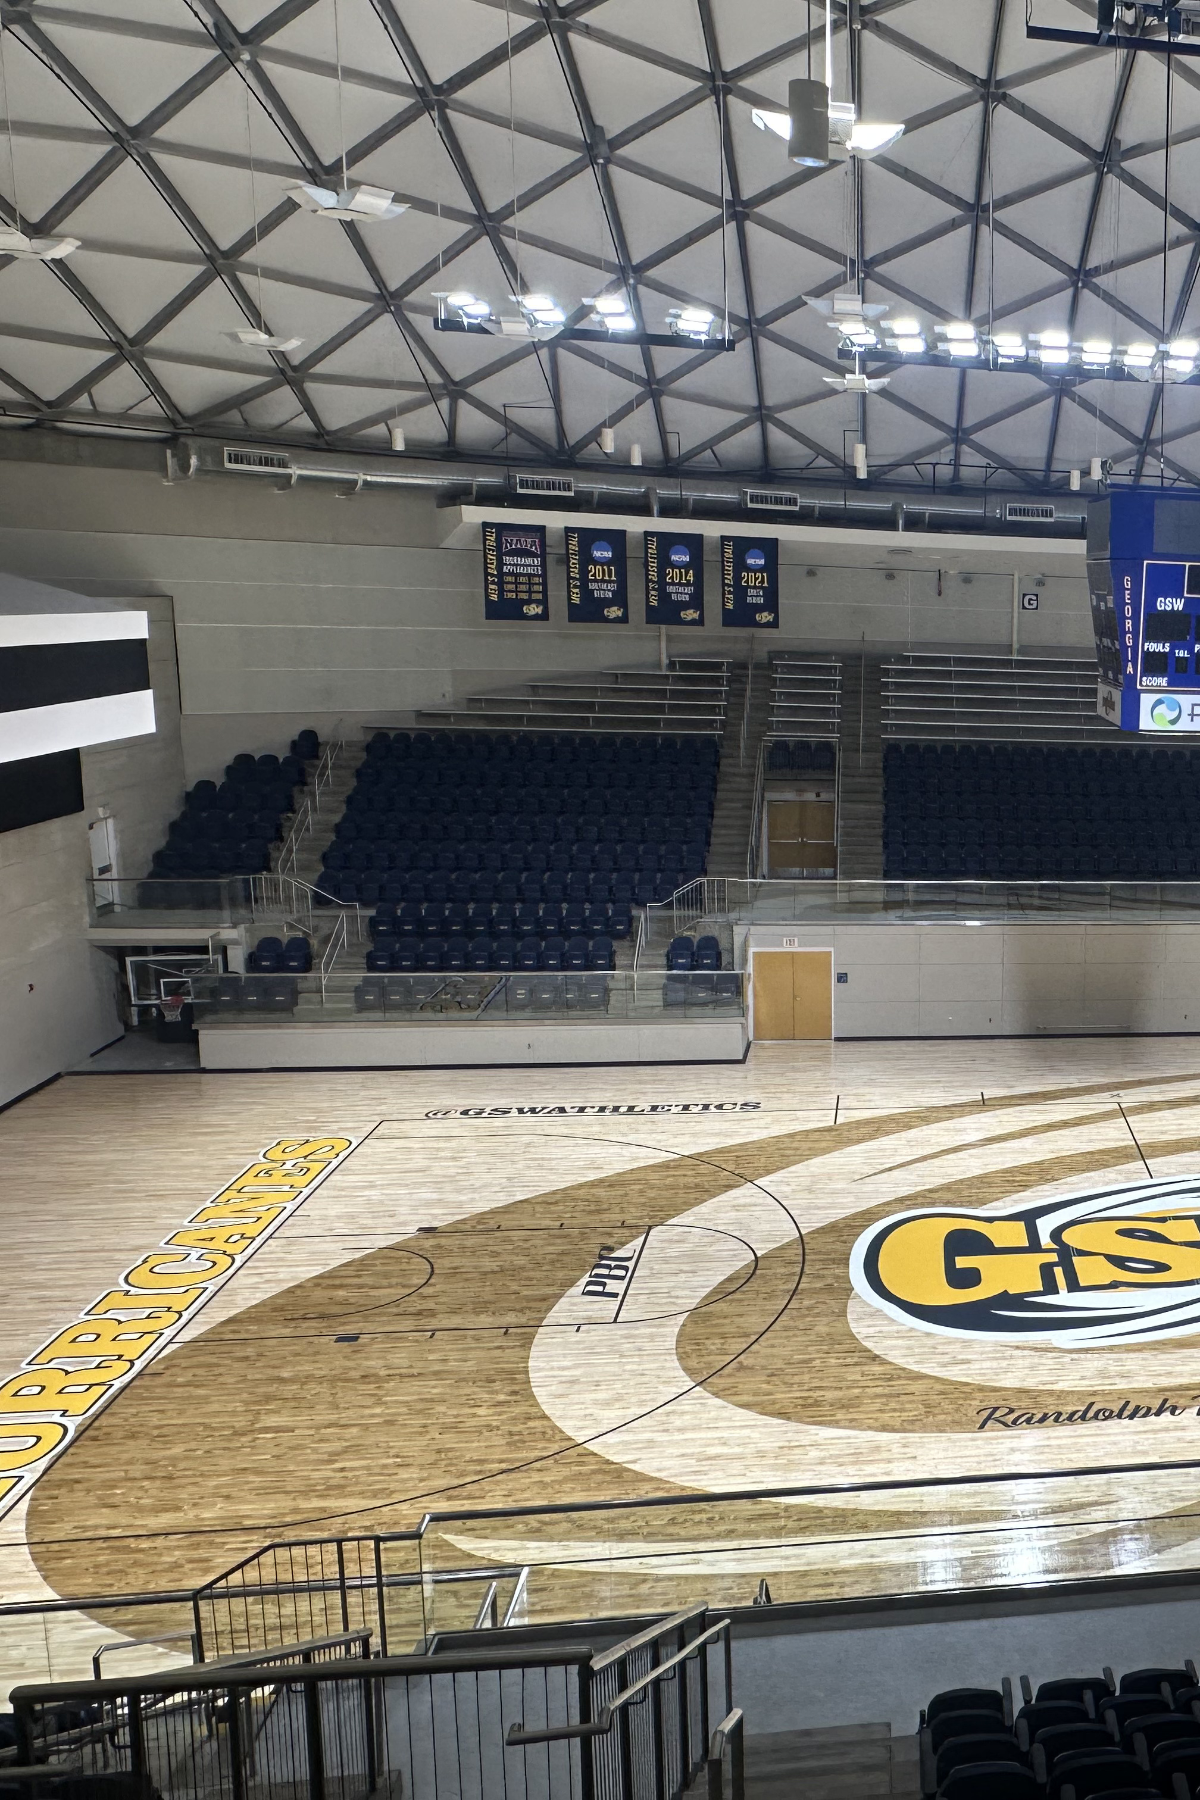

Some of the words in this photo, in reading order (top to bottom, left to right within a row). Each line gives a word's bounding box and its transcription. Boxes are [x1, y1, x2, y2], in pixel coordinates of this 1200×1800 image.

[588, 565, 617, 581] 2011
[666, 569, 694, 583] 2014
[741, 572, 769, 587] 2021
[1024, 594, 1038, 609] G
[1156, 597, 1184, 611] GSW
[1123, 576, 1134, 675] GEORGIA
[1144, 642, 1170, 653] FOULS
[1141, 677, 1168, 687] SCORE
[581, 1245, 637, 1299] PBC
[0, 1136, 355, 1500] URRICANES
[976, 1397, 1188, 1431] Randolph
